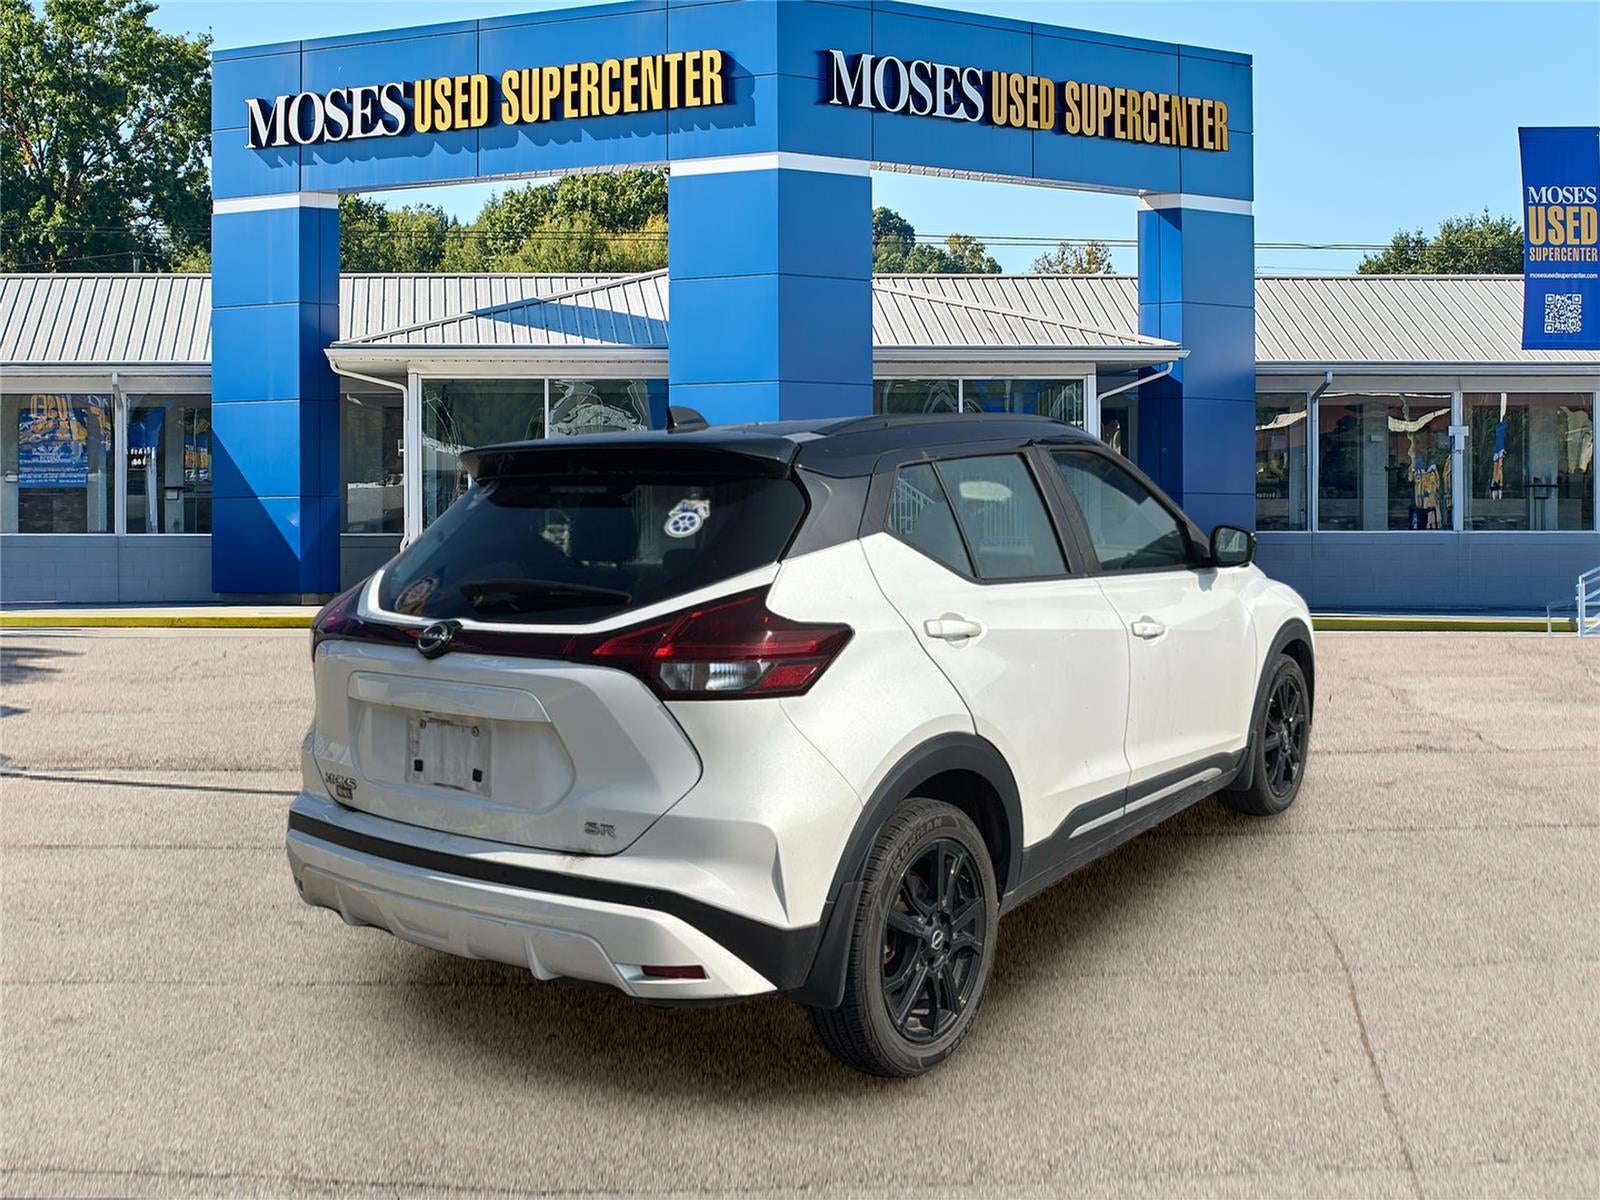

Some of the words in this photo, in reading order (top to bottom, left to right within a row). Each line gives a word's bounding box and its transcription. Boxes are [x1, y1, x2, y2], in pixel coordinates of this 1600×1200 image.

[244, 82, 407, 149] MOSES
[414, 74, 489, 133] USED
[502, 48, 724, 125] SUPERCENTER
[829, 49, 985, 122] MOSES
[991, 71, 1056, 131] USED
[1066, 80, 1230, 152] SUPERCENTER
[1528, 186, 1597, 204] MOSES
[1528, 206, 1598, 246] USED
[1529, 247, 1598, 262] SUPERCENTER
[584, 821, 616, 839] SR
